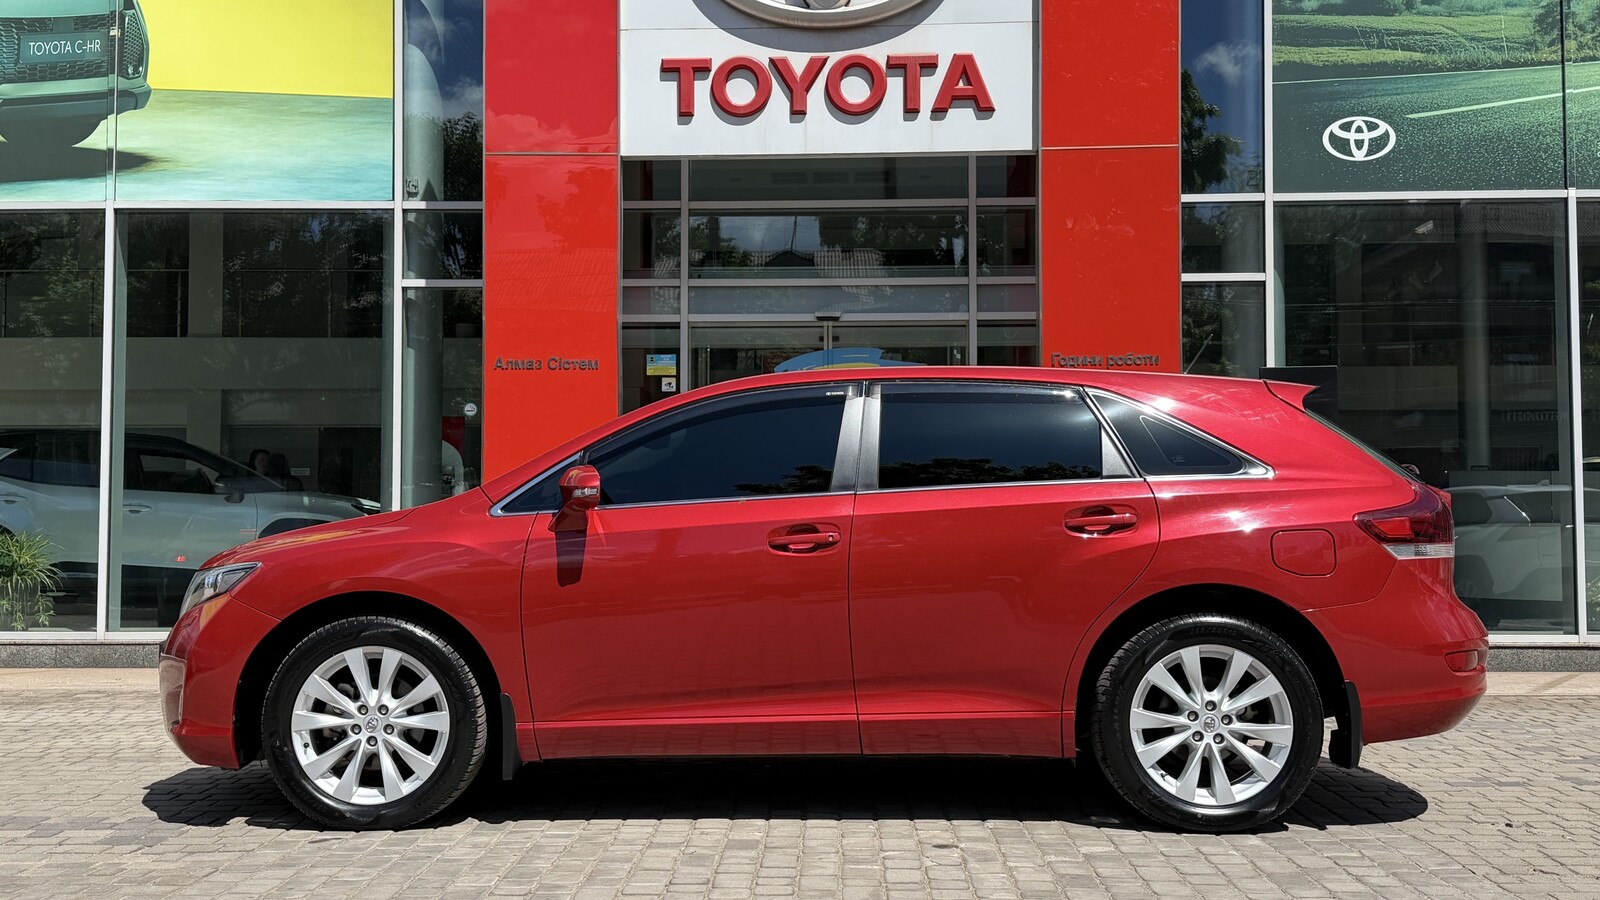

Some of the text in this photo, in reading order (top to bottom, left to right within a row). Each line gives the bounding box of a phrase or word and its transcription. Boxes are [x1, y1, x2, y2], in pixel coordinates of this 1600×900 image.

[28, 39, 101, 55] TOYOTA C-HR
[660, 53, 996, 116] TOYOTA
[494, 356, 599, 370] Алмаз Сістем
[1051, 352, 1160, 369] Години роботи
